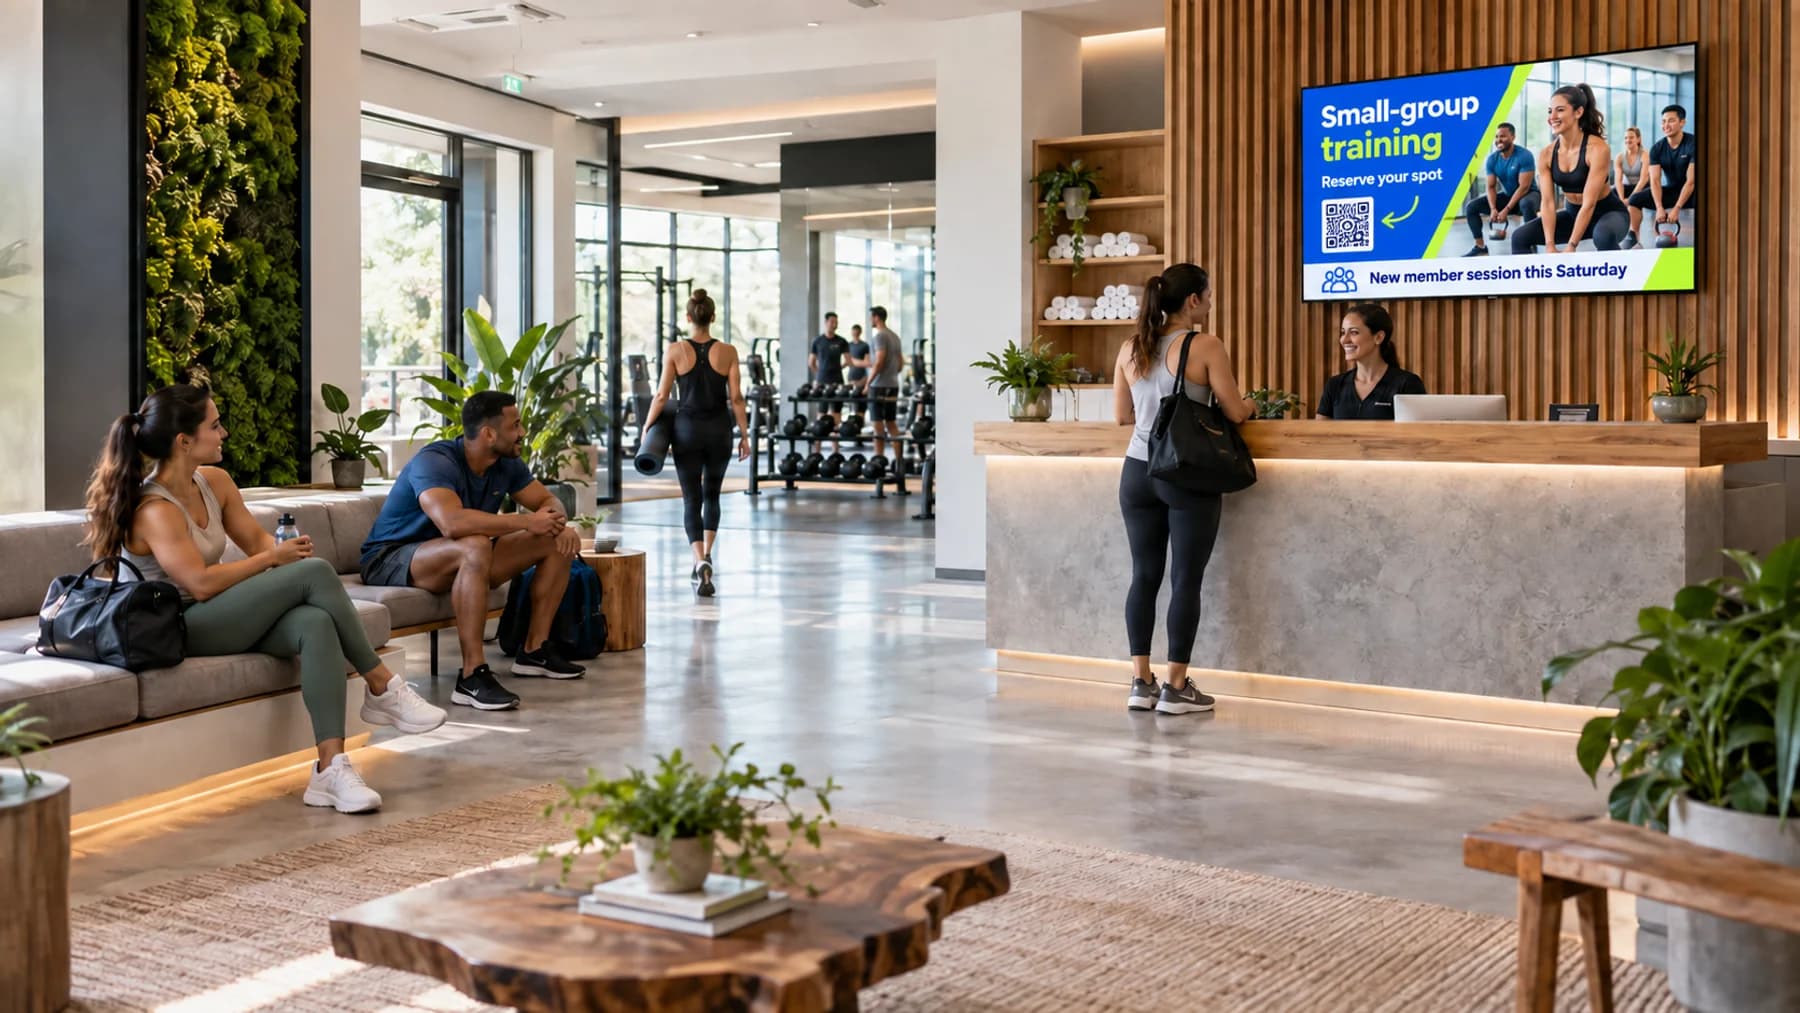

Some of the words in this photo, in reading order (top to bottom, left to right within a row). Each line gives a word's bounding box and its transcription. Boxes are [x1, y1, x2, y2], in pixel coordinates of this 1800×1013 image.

[1321, 96, 1479, 128] Small-group
[1321, 128, 1442, 162] training
[1321, 175, 1375, 188] Reserve
[1377, 172, 1408, 187] your
[1411, 168, 1443, 184] spot
[1370, 271, 1400, 284] New
[1404, 269, 1463, 283] member
[1466, 266, 1521, 281] session
[1525, 265, 1553, 279] this
[1556, 262, 1628, 279] Saturday
